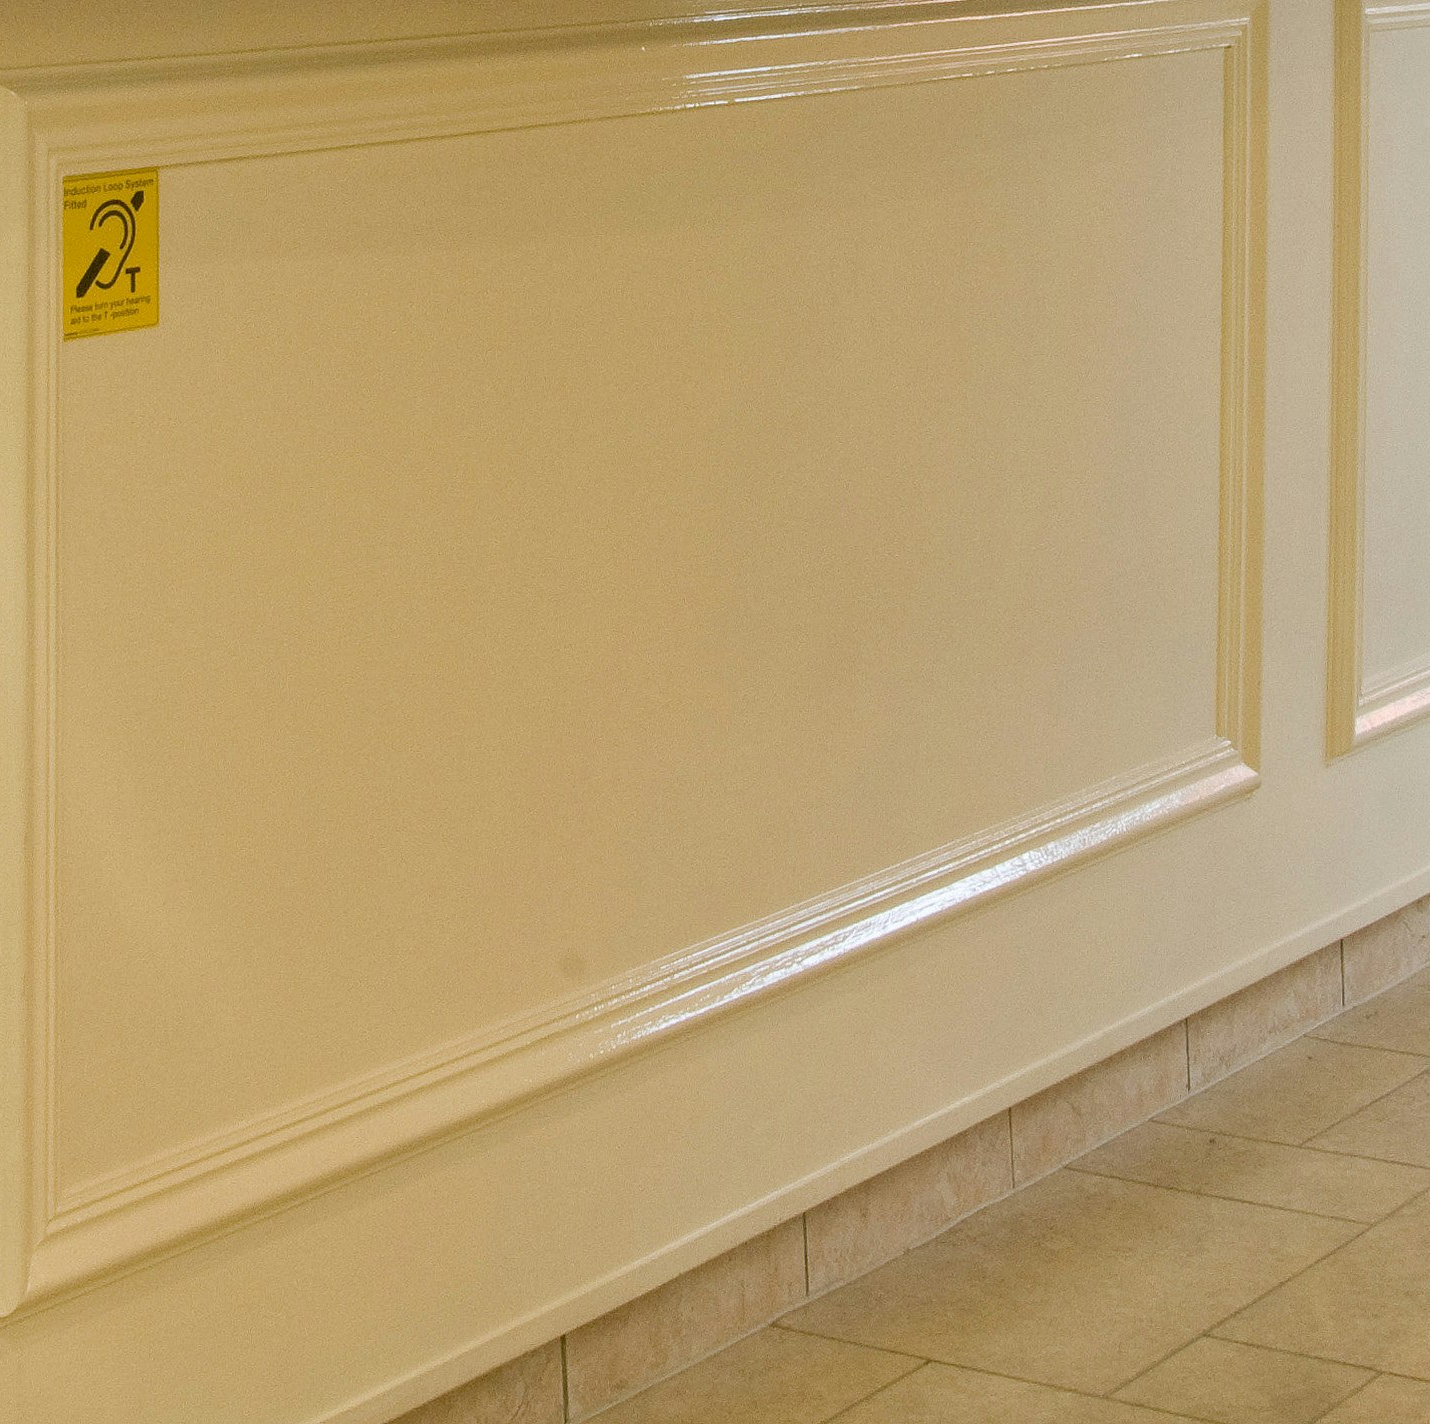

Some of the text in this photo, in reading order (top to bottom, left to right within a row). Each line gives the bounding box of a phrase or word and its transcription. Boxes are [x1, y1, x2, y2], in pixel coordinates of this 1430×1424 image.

[63, 178, 155, 197] Induction Loop System
[63, 199, 87, 211] Fitted
[70, 294, 151, 314] Please turn your hearing
